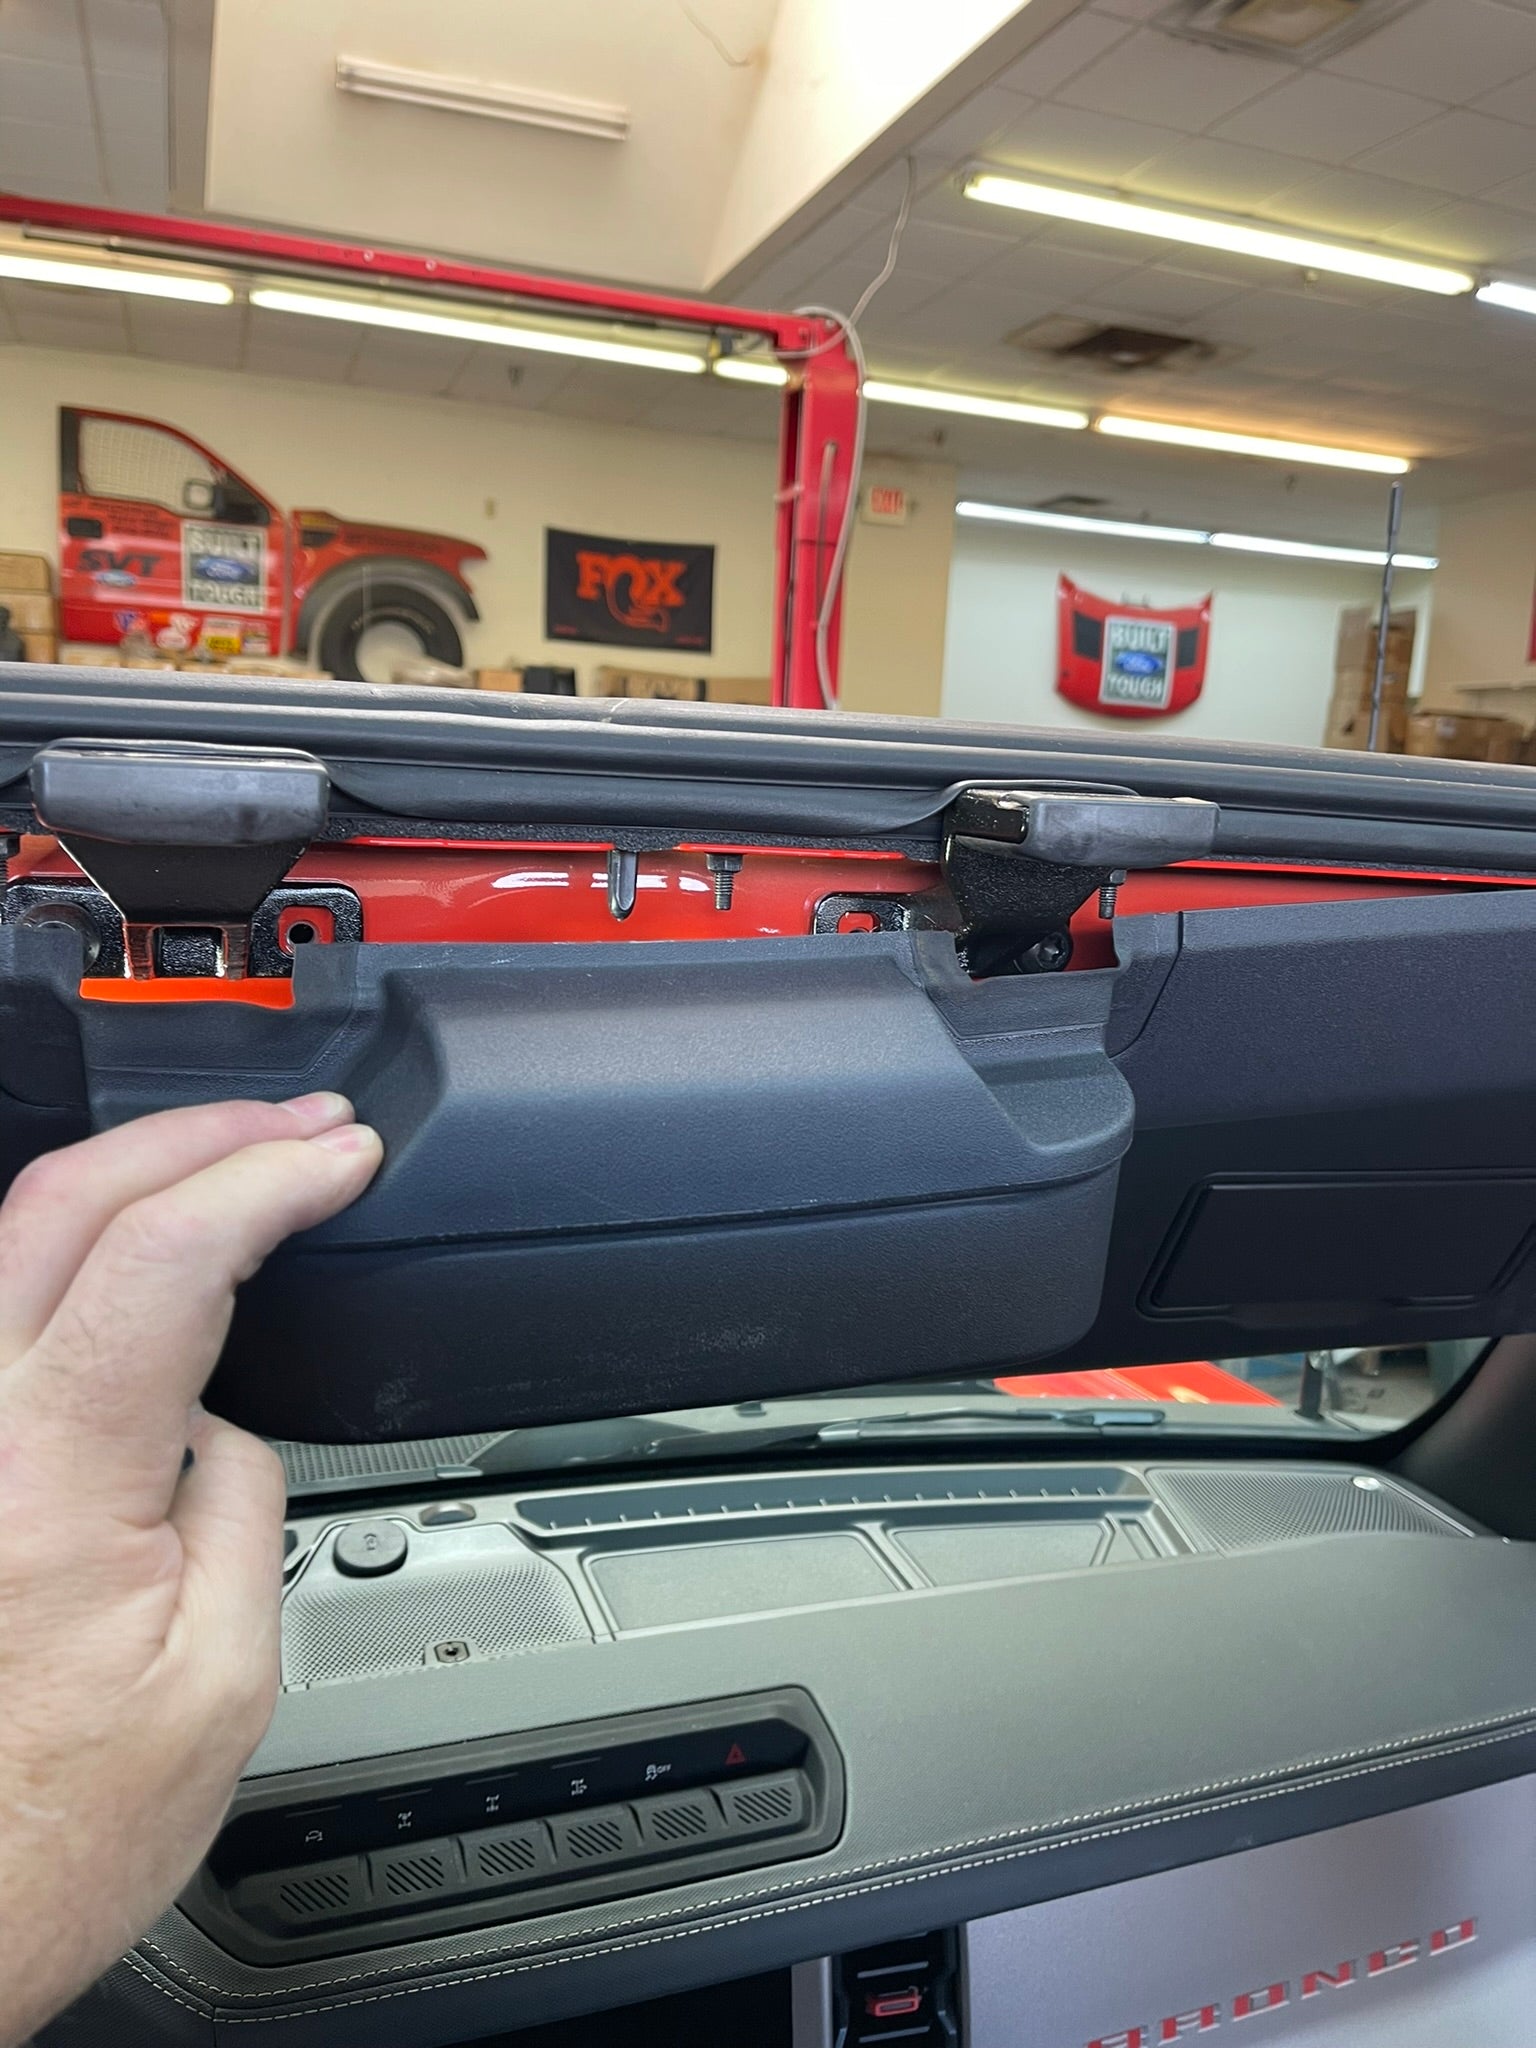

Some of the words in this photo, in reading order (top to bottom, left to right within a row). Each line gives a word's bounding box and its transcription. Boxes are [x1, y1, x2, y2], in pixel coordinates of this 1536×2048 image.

[78, 549, 163, 577] SVT
[576, 551, 688, 610] FOX
[1111, 624, 1168, 653] BUILT
[1106, 673, 1163, 699] TOUGH
[656, 1763, 672, 1774] OFF
